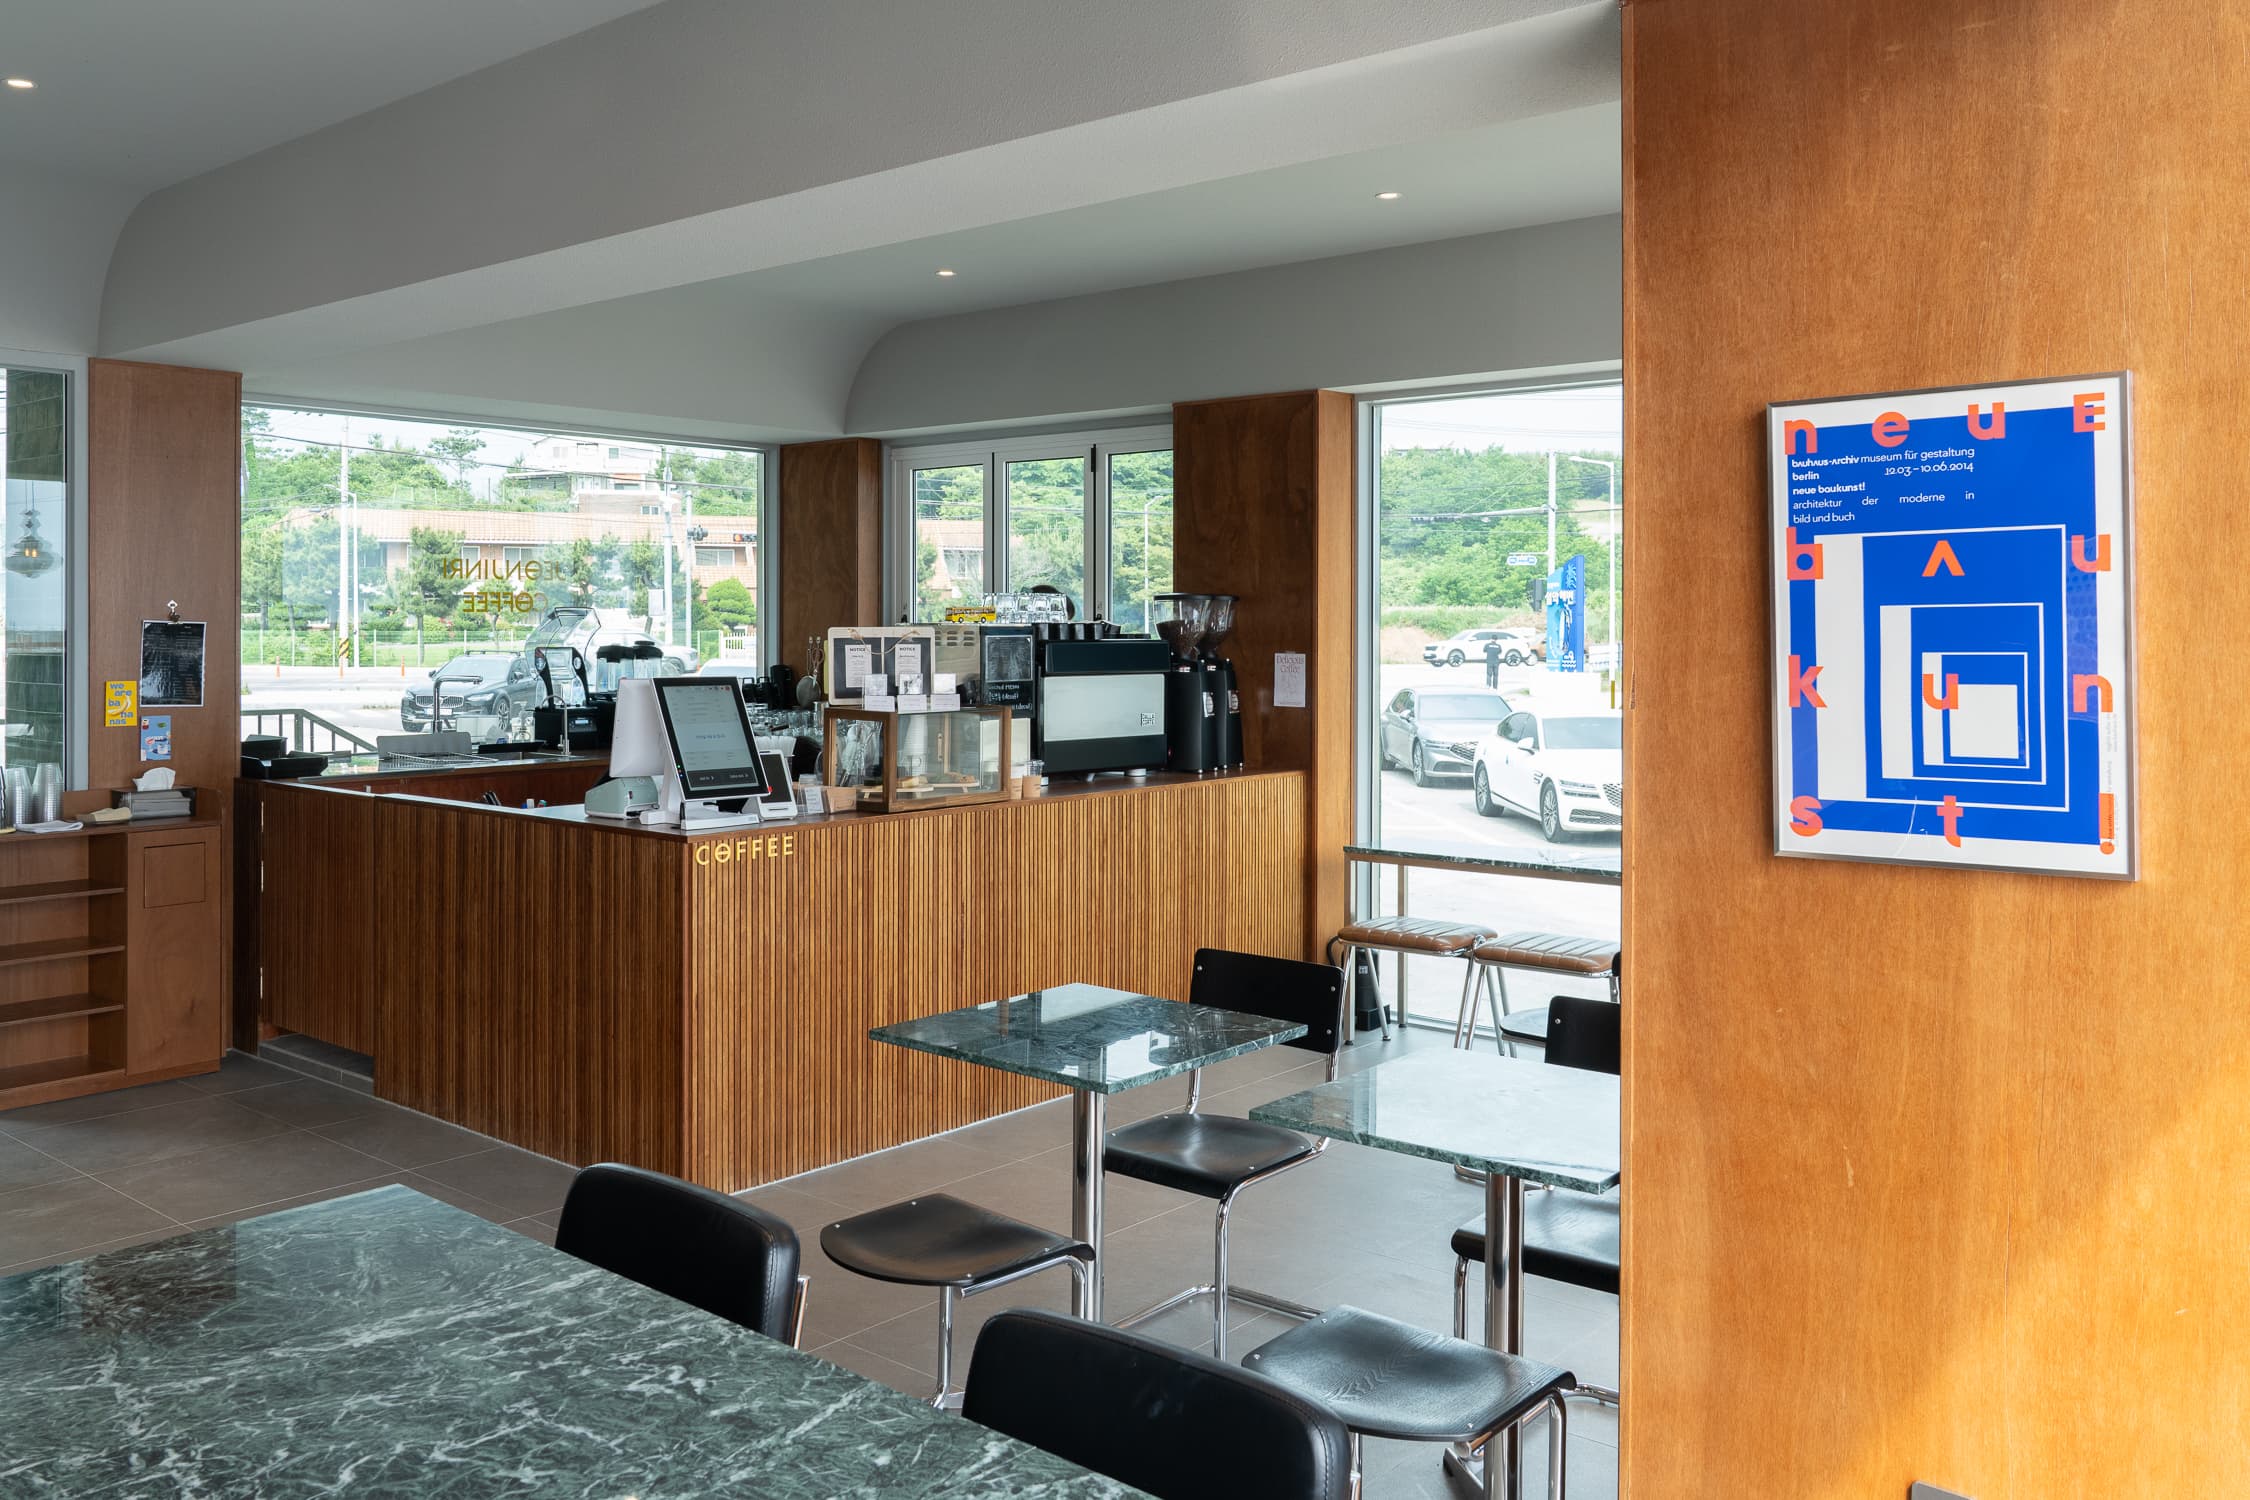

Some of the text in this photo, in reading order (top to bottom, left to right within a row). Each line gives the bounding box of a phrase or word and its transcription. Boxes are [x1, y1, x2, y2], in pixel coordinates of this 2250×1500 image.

[1860, 453, 1903, 464] museum
[1903, 449, 1918, 460] für
[1920, 447, 1975, 461] gestaltung
[1792, 471, 1820, 481] berlin
[1792, 482, 1866, 495] neue baukunst!
[1793, 490, 1975, 510] architektur der moderne in
[1793, 512, 1855, 524] bild und buch
[695, 835, 794, 866] COFFEE
